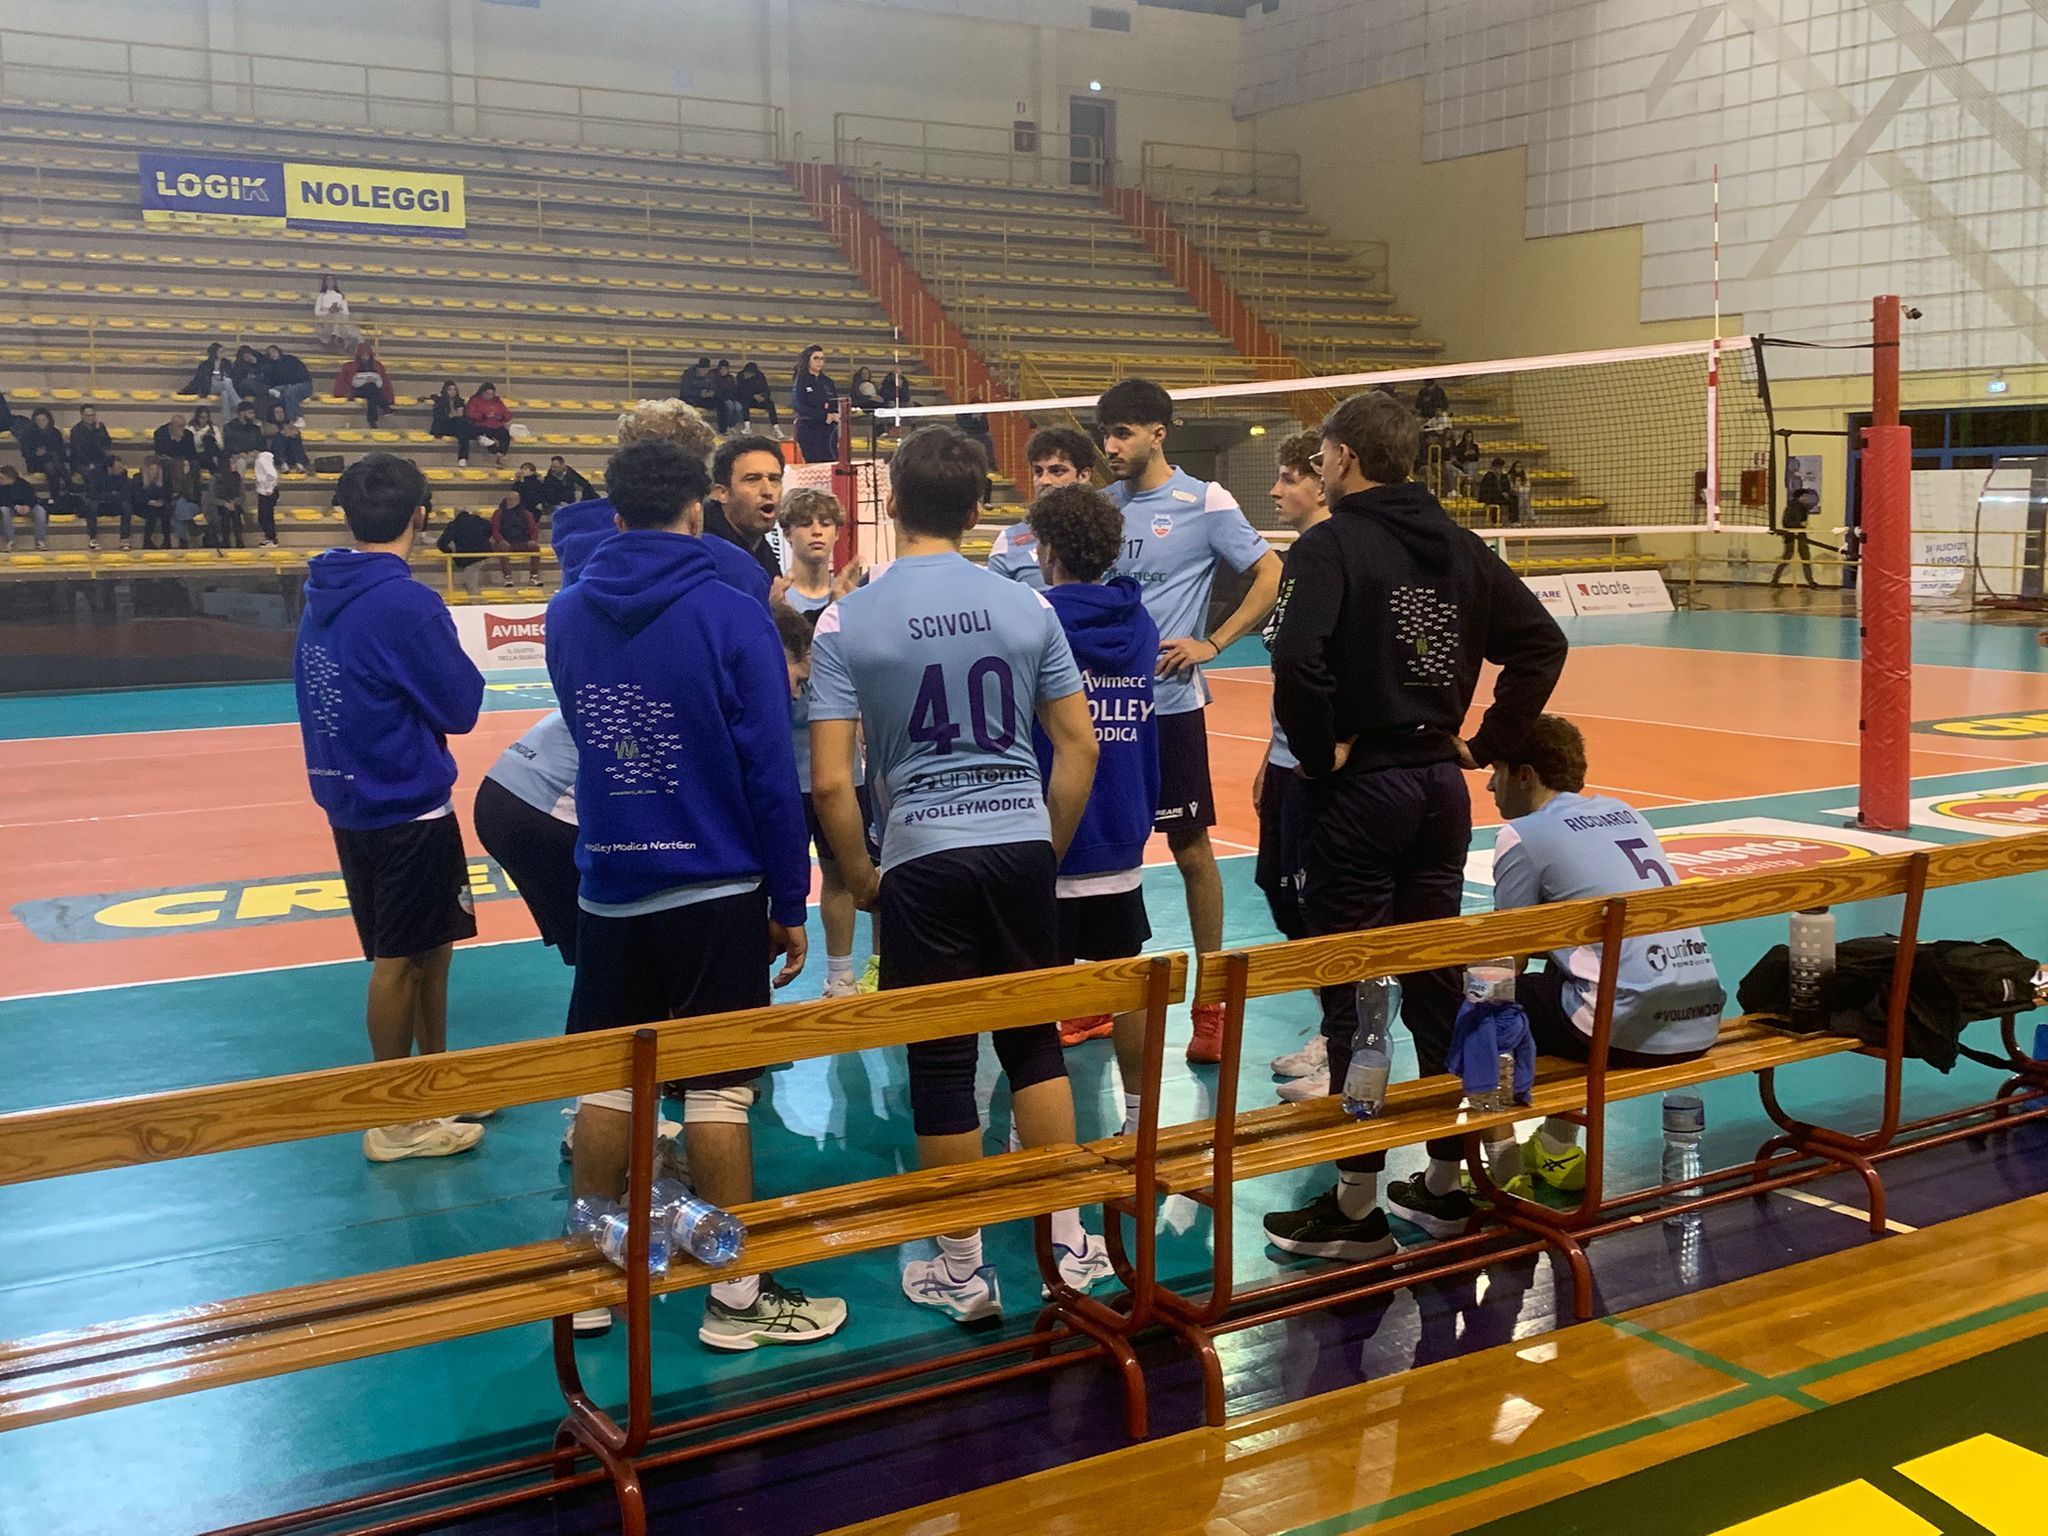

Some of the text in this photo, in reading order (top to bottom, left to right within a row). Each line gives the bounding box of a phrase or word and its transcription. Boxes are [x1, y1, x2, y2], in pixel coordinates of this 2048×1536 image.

[156, 171, 270, 202] LOGIK
[300, 180, 450, 212] NOLEGGI
[1127, 539, 1143, 559] 17
[1535, 590, 1562, 599] EARE
[1590, 581, 1632, 596] abate
[908, 609, 993, 640] SCIVOLI
[1081, 669, 1147, 693] Avimecc
[908, 655, 1016, 755] 40
[1087, 699, 1155, 722] OLLEY
[1093, 727, 1138, 742] ODICA
[904, 797, 1037, 826] #VOLLEYMODICA
[1563, 810, 1638, 832] RICCIARDO
[613, 842, 648, 852] Modica
[650, 841, 696, 850] NextGen
[1614, 838, 1672, 887] 5
